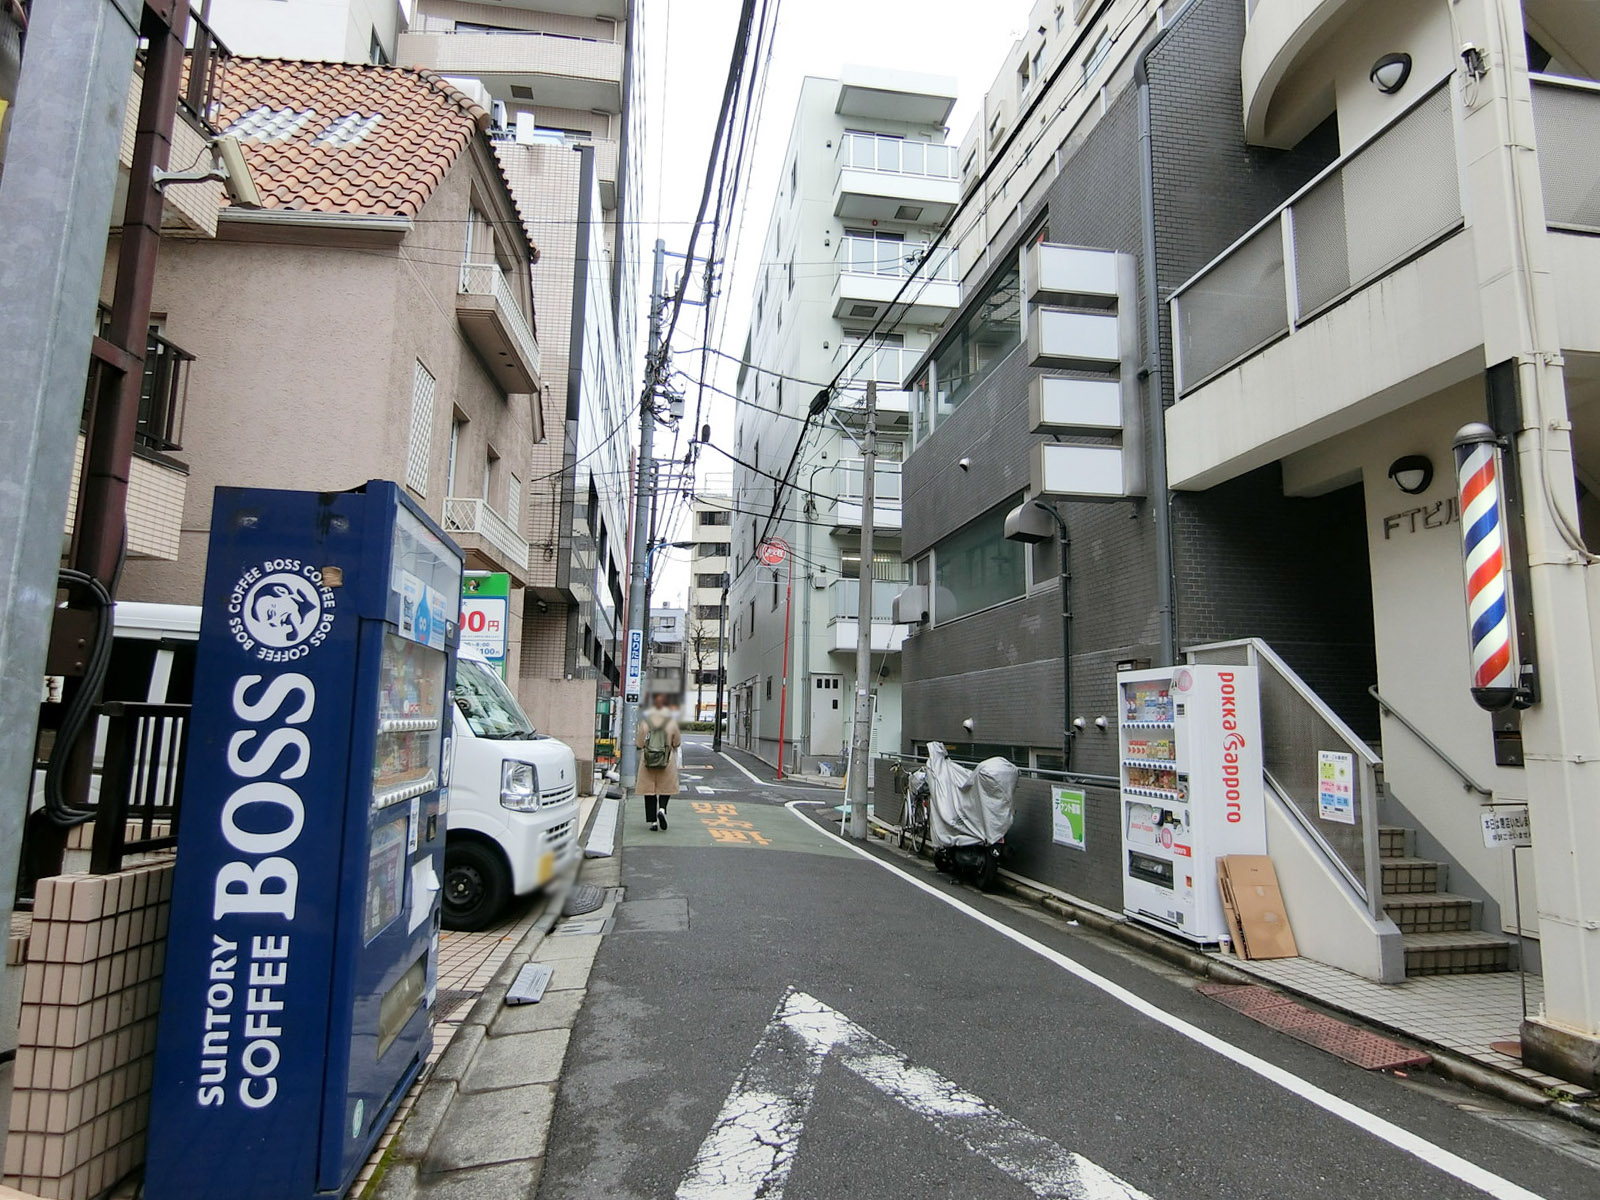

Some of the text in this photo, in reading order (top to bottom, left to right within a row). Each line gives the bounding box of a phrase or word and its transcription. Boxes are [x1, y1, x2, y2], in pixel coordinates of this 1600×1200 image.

[264, 559, 301, 573] BOSS
[228, 567, 262, 613] COFFEE
[229, 617, 255, 651] BOSS
[310, 613, 335, 647] BOSS
[257, 644, 310, 662] COFFEE
[213, 672, 316, 920] BOSS
[239, 935, 290, 1109] COFFEE
